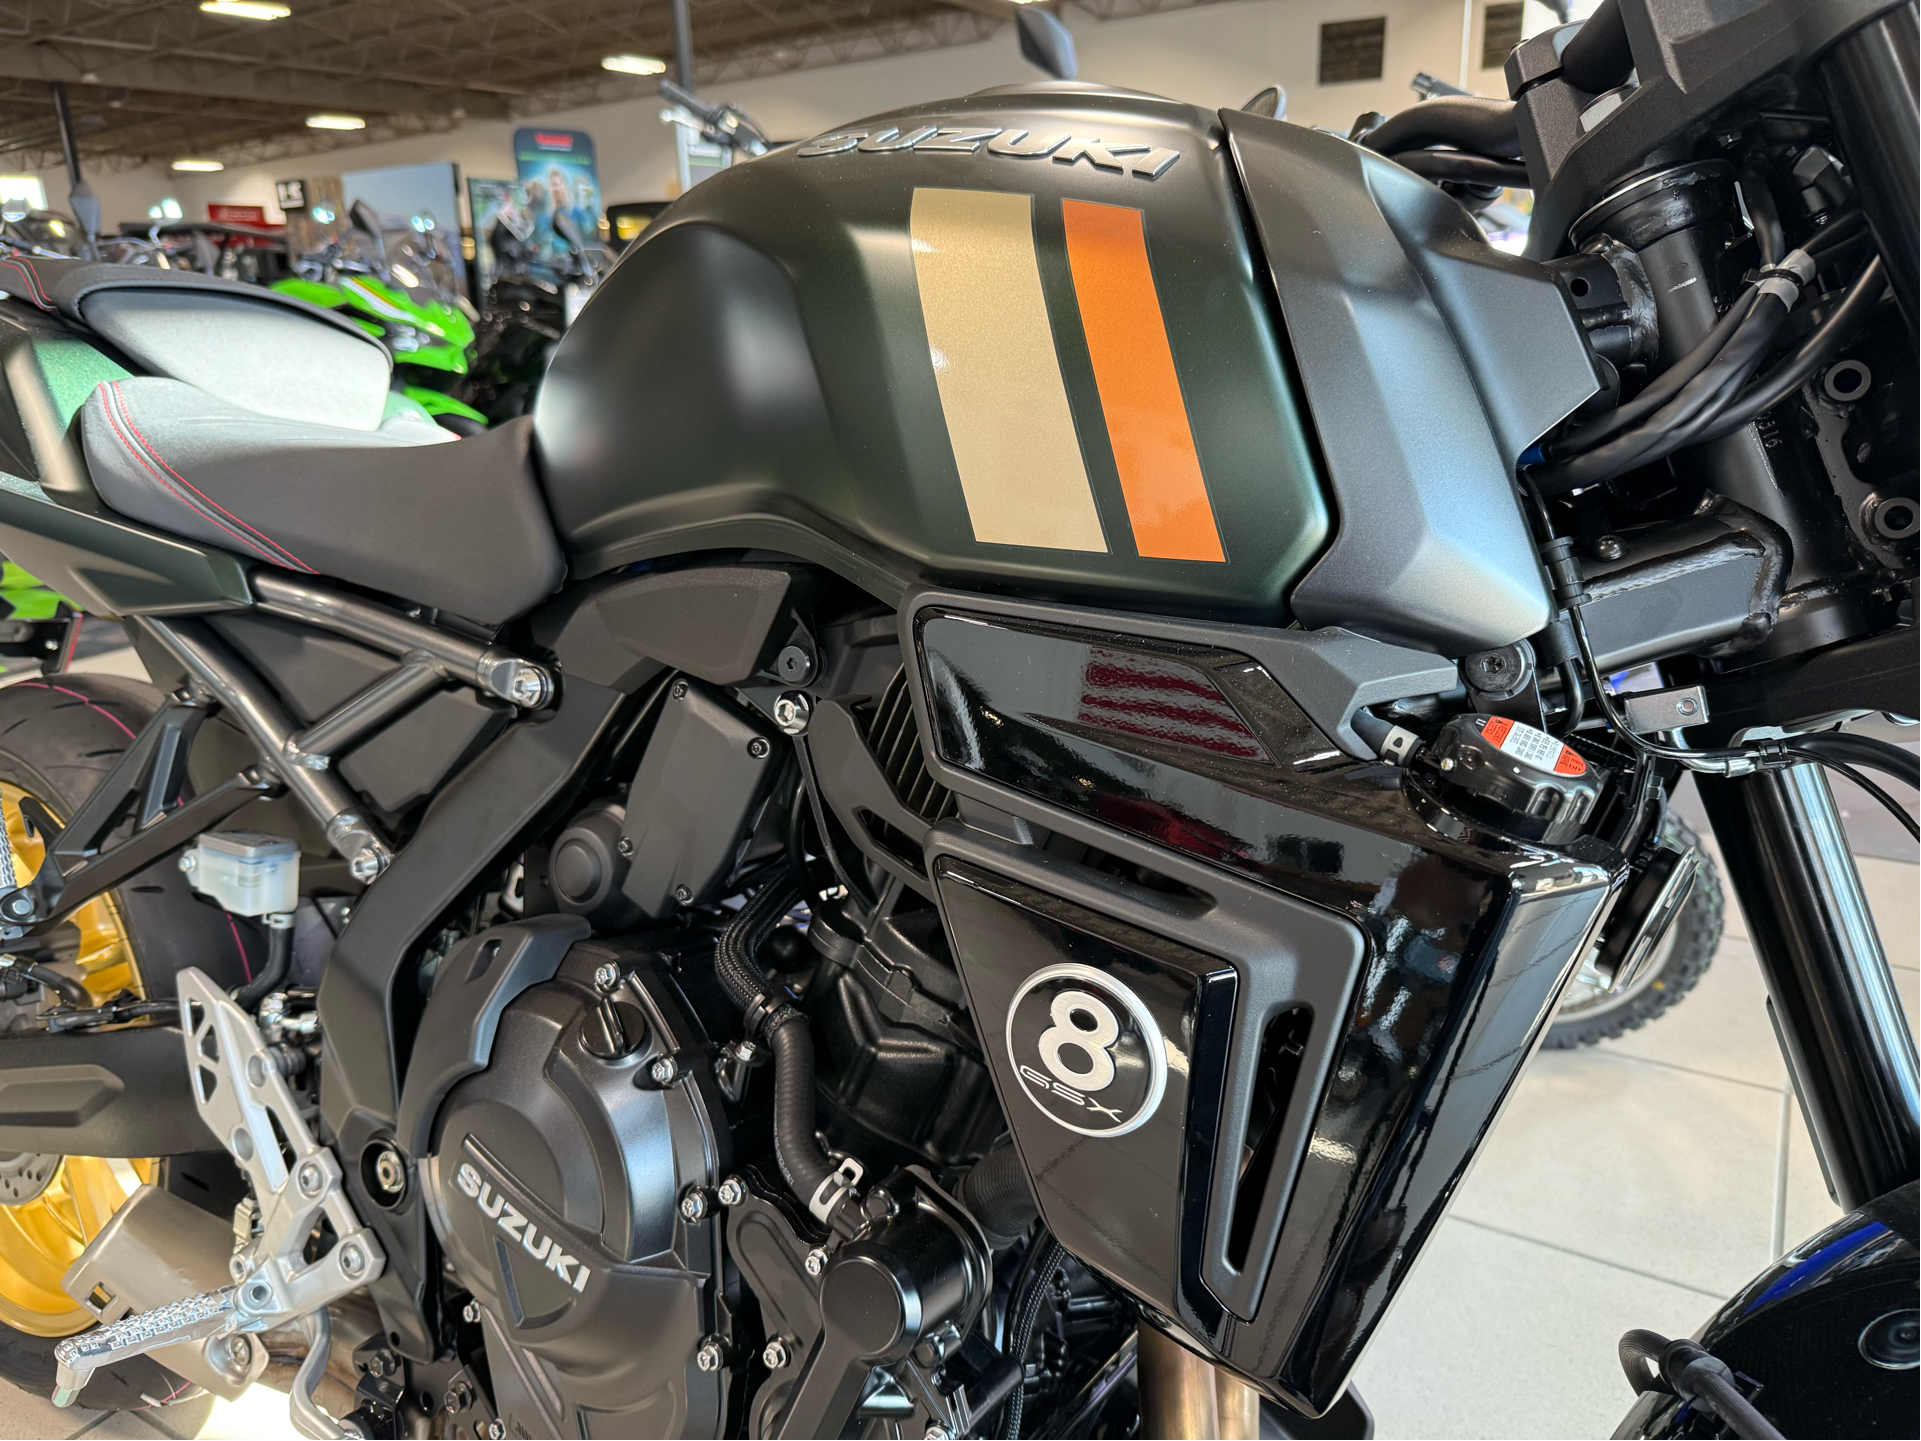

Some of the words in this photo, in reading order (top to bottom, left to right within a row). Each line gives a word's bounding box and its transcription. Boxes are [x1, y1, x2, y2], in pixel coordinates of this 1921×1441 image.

[797, 125, 1181, 178] SUZUKI
[1039, 991, 1119, 1092] 8
[1020, 1065, 1123, 1123] GSX
[458, 1163, 591, 1293] SUZUKI
